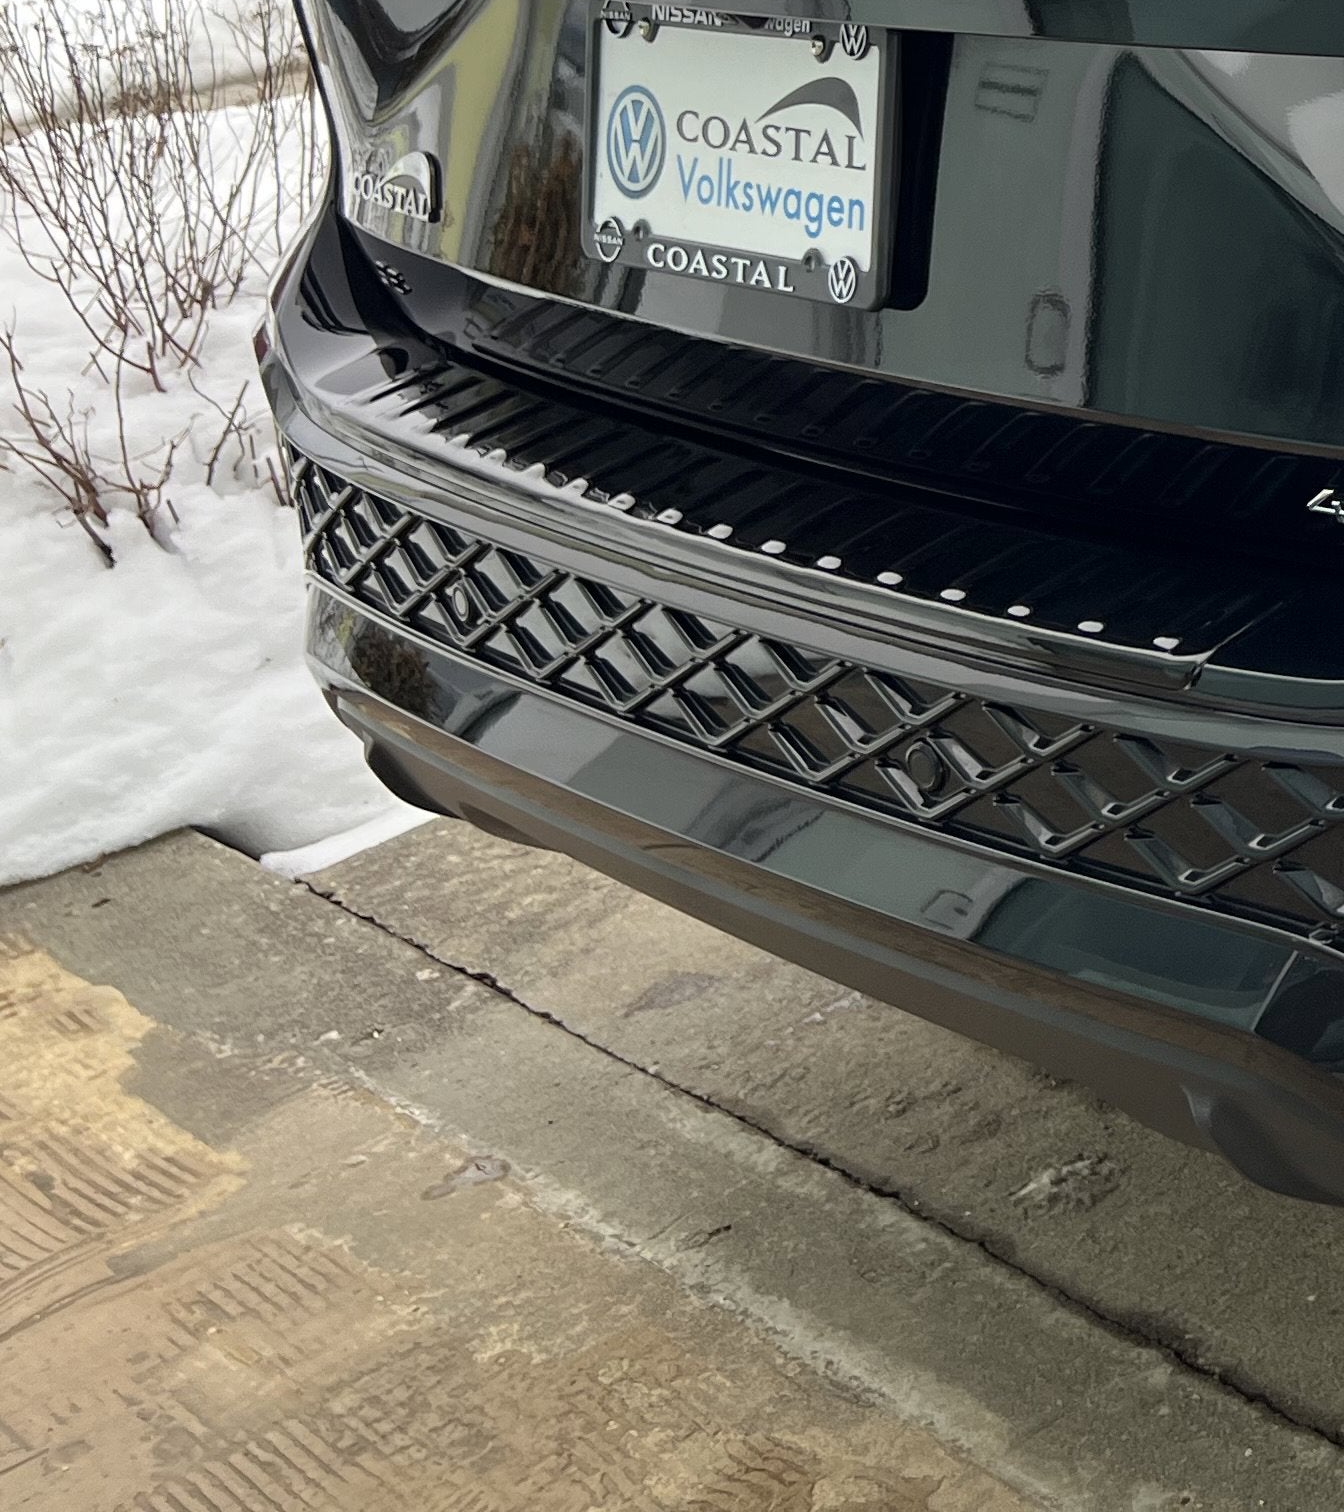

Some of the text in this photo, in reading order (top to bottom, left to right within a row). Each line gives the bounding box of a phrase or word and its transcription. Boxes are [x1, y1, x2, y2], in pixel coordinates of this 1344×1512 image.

[651, 3, 724, 27] NISSAN
[676, 110, 867, 171] COASTAL
[353, 171, 430, 222] COASTAL
[676, 154, 865, 239] Volkswagen
[646, 242, 796, 293] COASTAL
